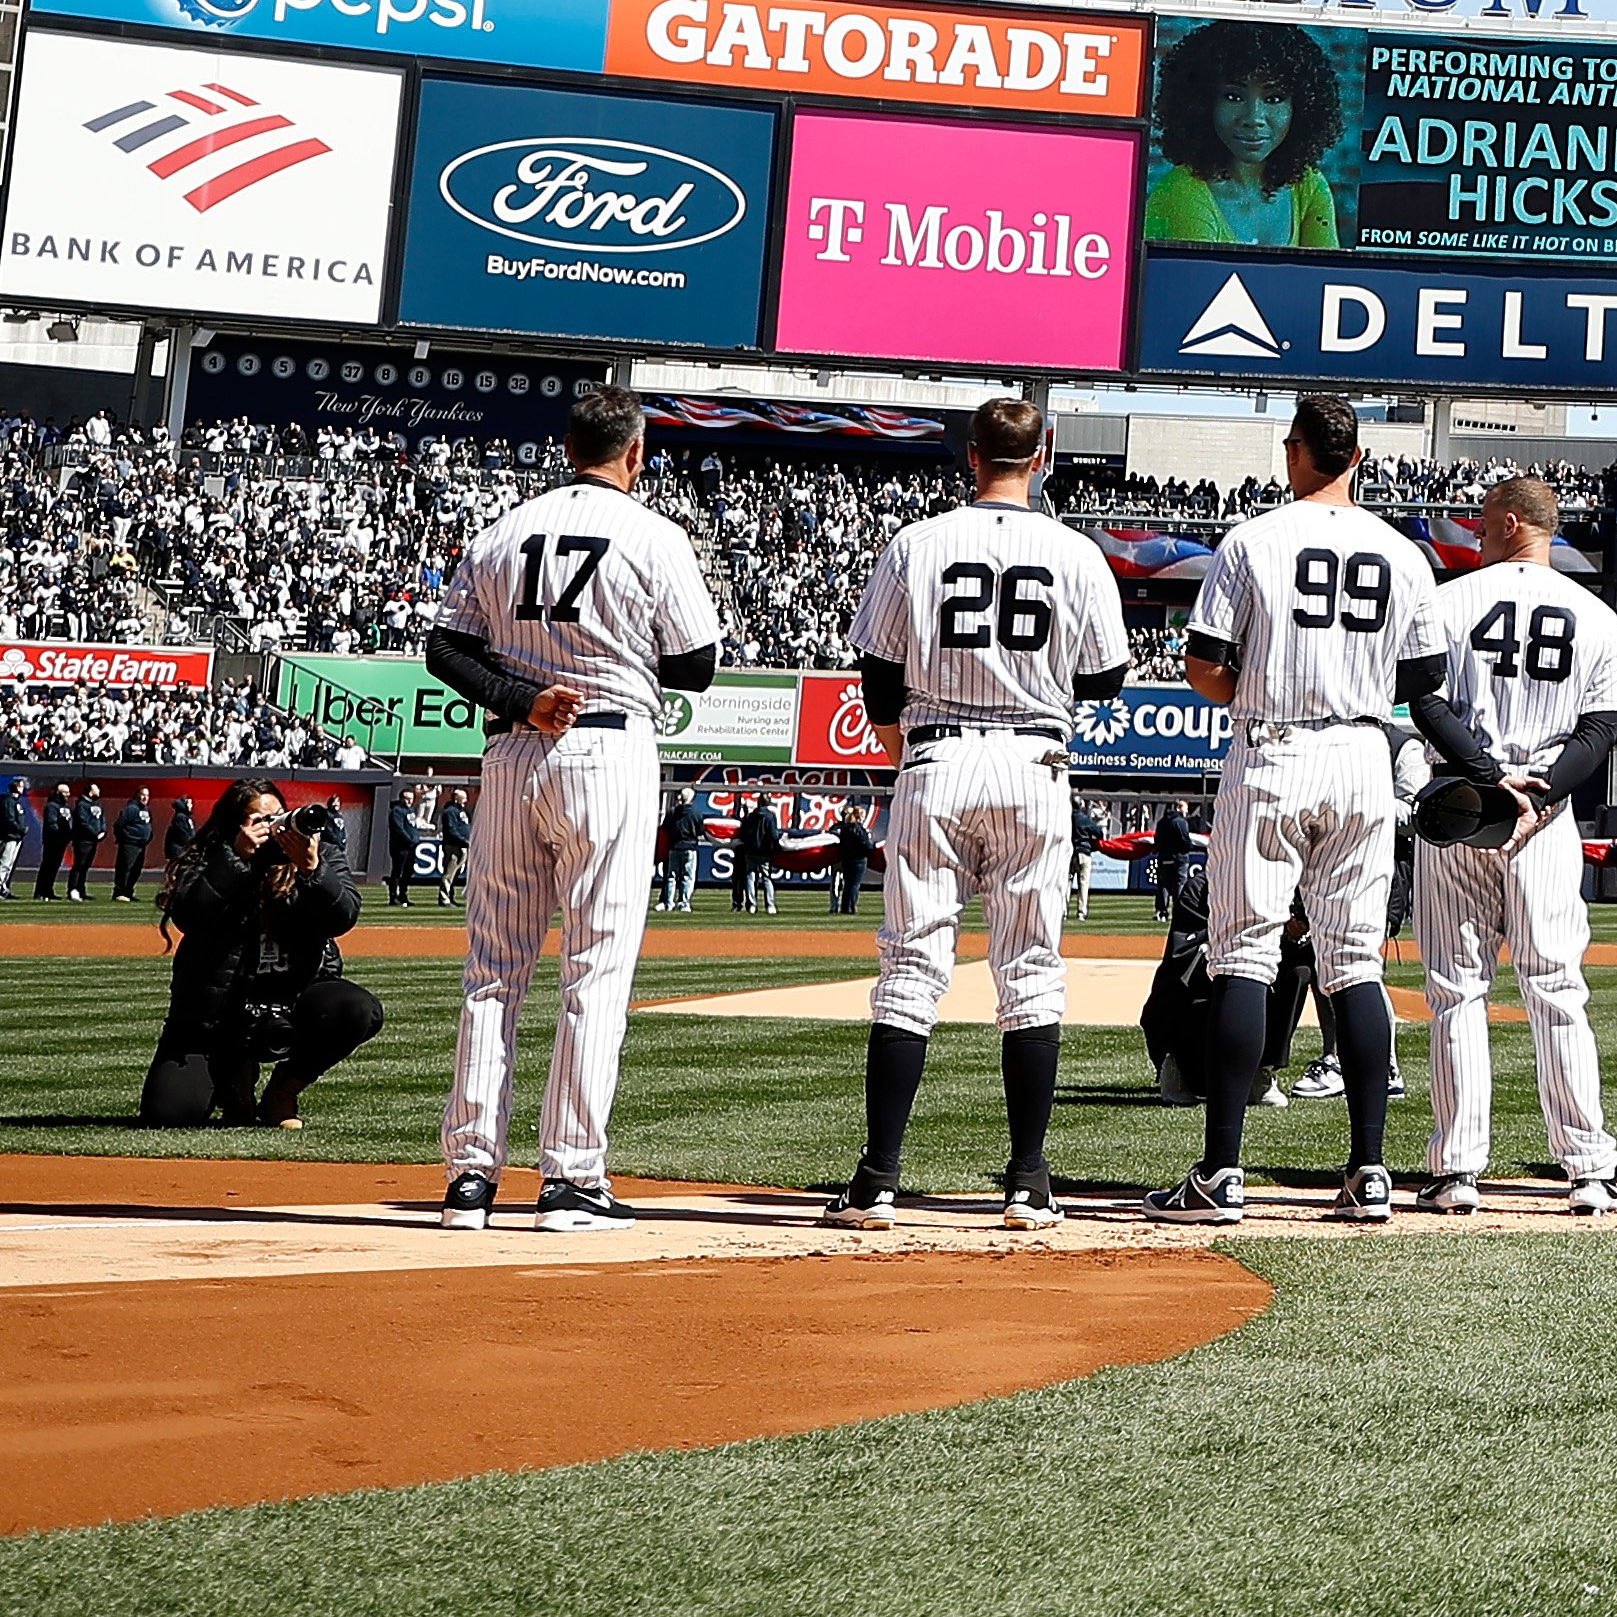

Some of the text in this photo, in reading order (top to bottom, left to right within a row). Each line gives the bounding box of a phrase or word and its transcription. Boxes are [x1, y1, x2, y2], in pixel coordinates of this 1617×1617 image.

[1372, 46, 1573, 80] PERFORMING
[1387, 74, 1541, 104] NATIONAL
[492, 150, 695, 239] Ford
[807, 197, 1111, 279] T Mobile
[1361, 228, 1412, 245] FROM
[1417, 231, 1468, 248] SOME
[1473, 234, 1508, 249] LIKE
[1512, 235, 1526, 249] IT
[1532, 236, 1569, 251] HOT
[1572, 239, 1599, 253] ON
[11, 232, 374, 285] BANK OF AMERICA
[486, 254, 686, 289] BuyFordNow.com
[314, 390, 484, 427] New York Yankees
[514, 533, 611, 623] 17
[1292, 547, 1391, 633] 99
[938, 562, 1055, 652] 26
[1470, 599, 1577, 684] 48
[293, 684, 404, 727] Uber
[699, 695, 791, 711] Morningside
[697, 726, 789, 736] Rehabilitation Center
[738, 716, 771, 726] Nursing
[1070, 752, 1127, 766] Business
[1130, 753, 1171, 768] Spend
[1225, 1184, 1243, 1204] 99
[1365, 1180, 1385, 1199] 99
